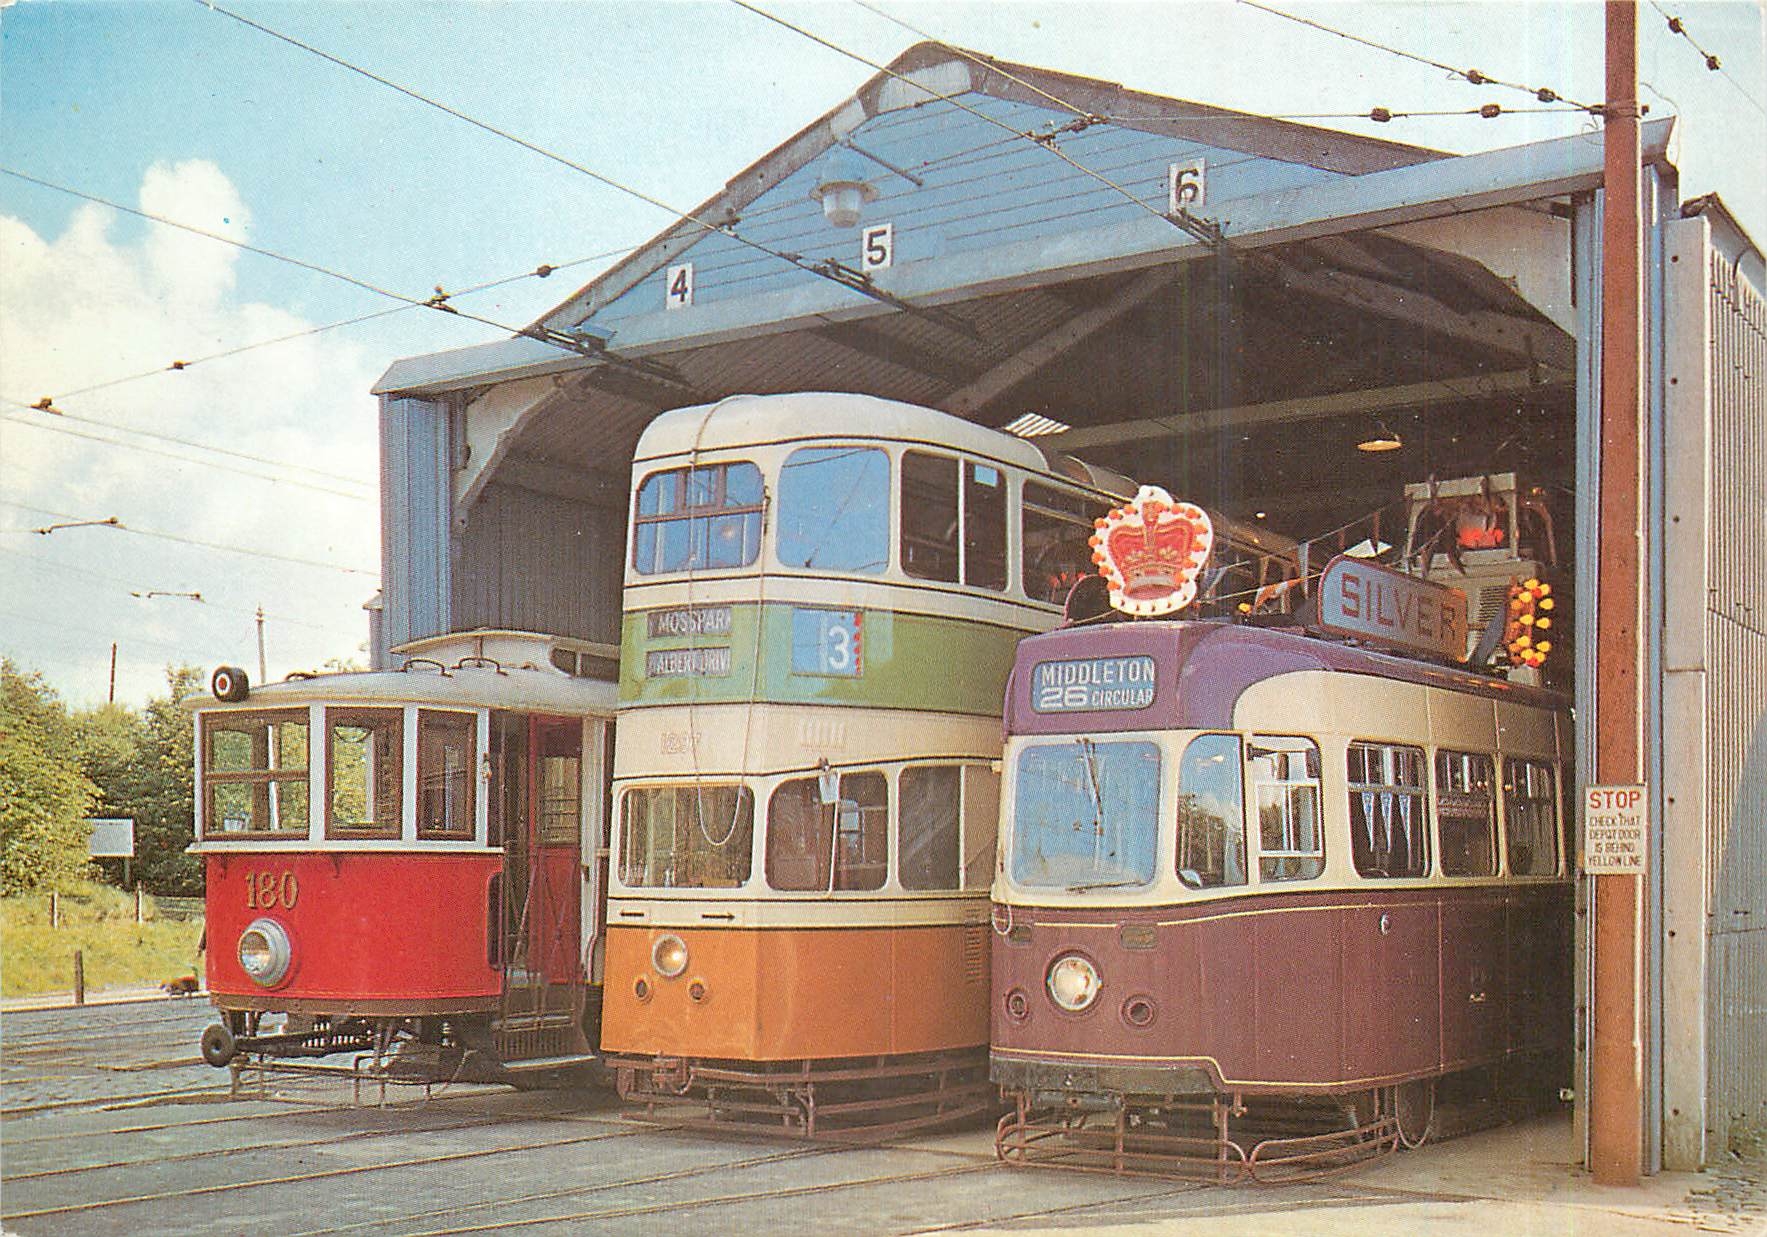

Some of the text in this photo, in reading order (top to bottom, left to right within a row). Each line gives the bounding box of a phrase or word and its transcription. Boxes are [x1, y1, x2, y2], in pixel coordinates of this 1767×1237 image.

[1176, 168, 1198, 203] 6
[867, 229, 887, 265] 5
[670, 269, 688, 302] 4
[1341, 572, 1458, 641] SILVER
[828, 625, 850, 670] 3
[1041, 660, 1155, 686] MIDDLETON
[1040, 686, 1154, 707] 26 CIRCULAR
[1590, 790, 1641, 809] STOP
[1589, 815, 1640, 826] CHECK THAT
[1589, 829, 1641, 840] DEPOT DOOR
[1595, 842, 1635, 853] IS BEHIND
[1588, 856, 1641, 867] YELLOW LINE
[245, 870, 298, 909] 180
